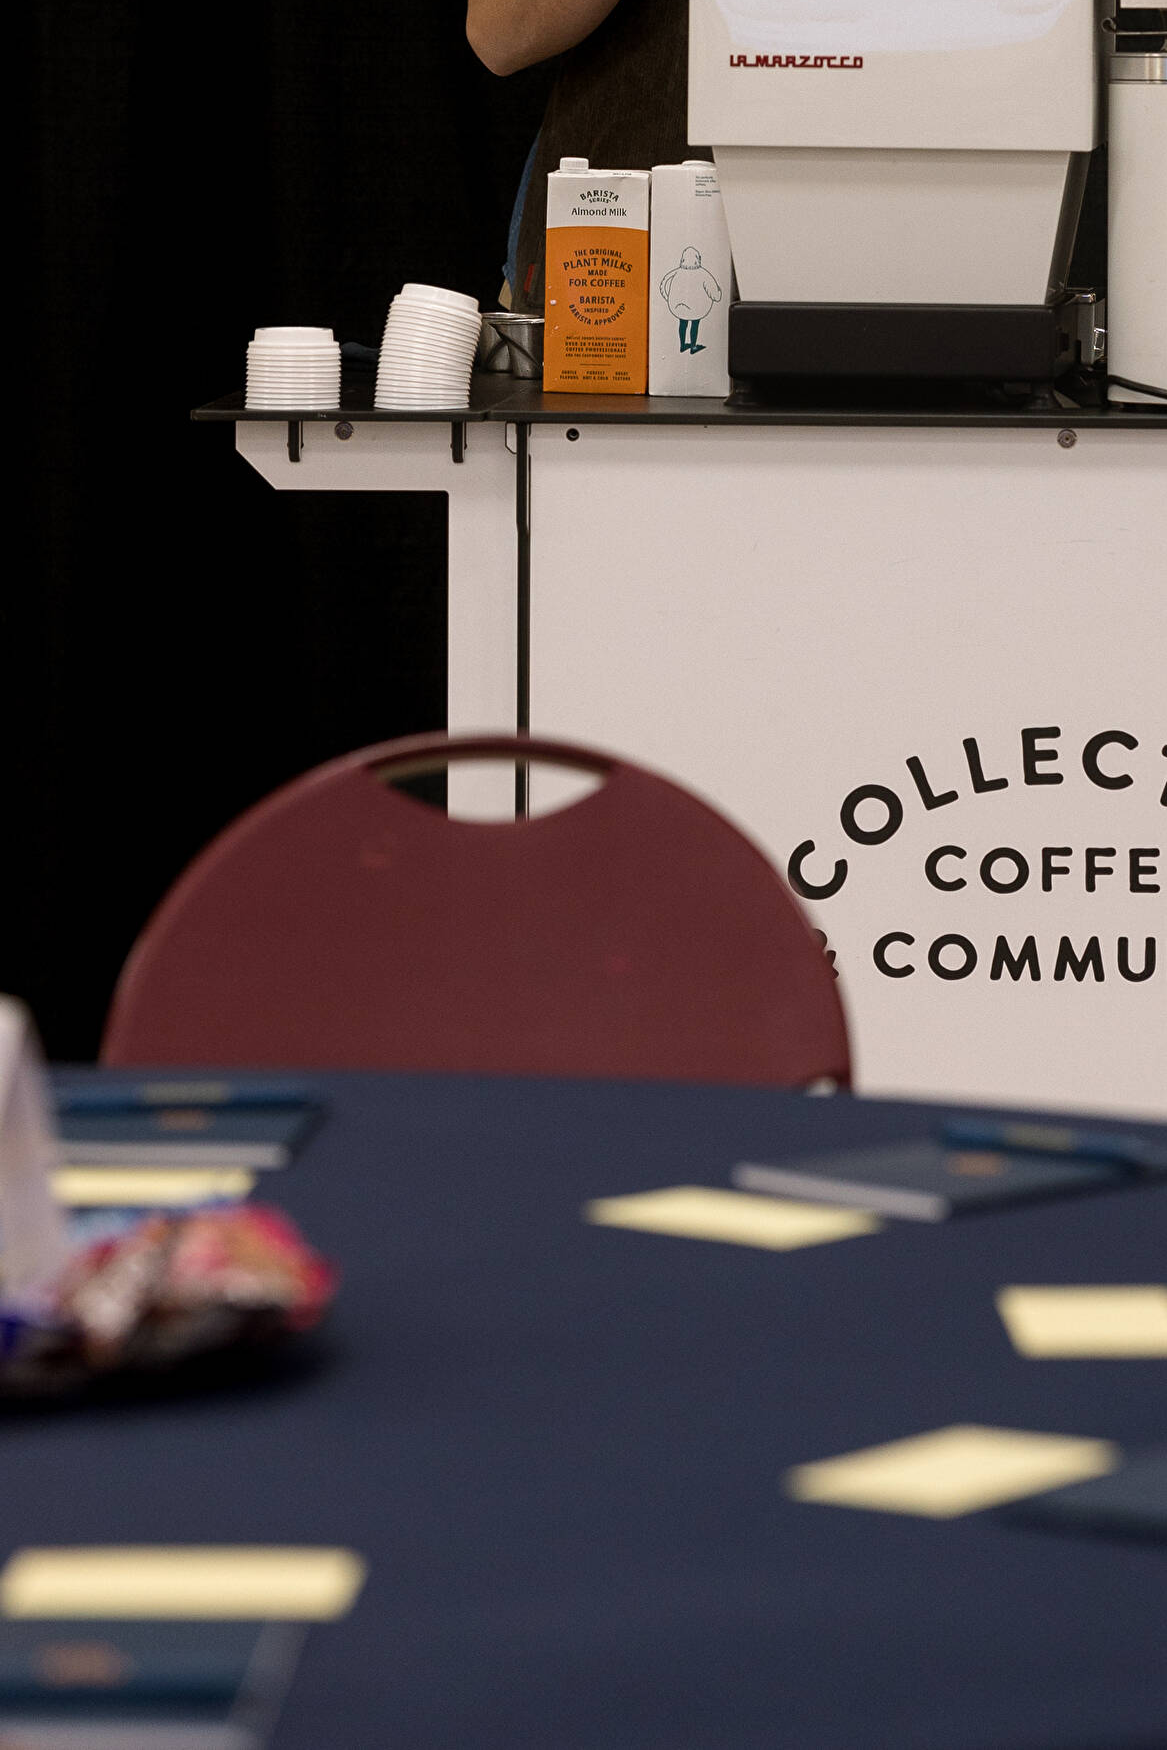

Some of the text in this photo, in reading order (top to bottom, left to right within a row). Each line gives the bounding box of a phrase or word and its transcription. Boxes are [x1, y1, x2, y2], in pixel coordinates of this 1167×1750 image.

[580, 190, 619, 203] BARISTA
[571, 207, 627, 217] Almond Milk
[574, 248, 622, 259] THE ORIGINAL
[563, 257, 633, 273] PLANT MILKS
[569, 278, 626, 288] FOR COFFEE
[579, 296, 615, 304] BARISTA
[569, 304, 591, 325] BARISTA
